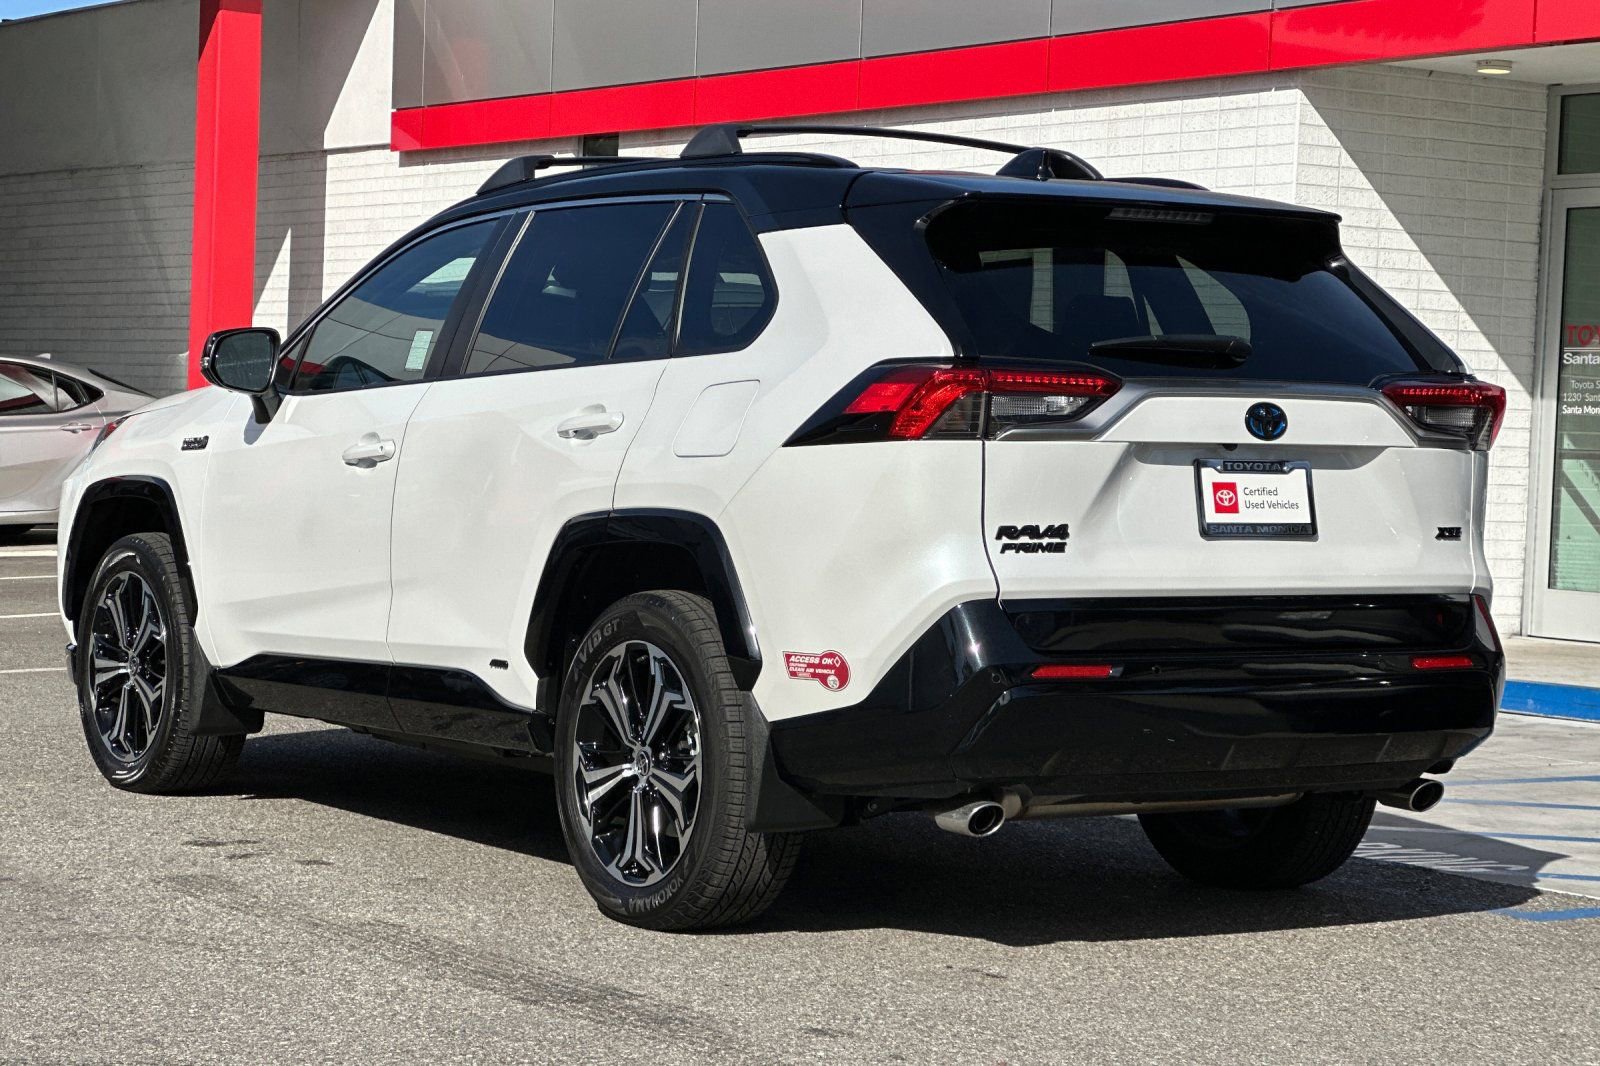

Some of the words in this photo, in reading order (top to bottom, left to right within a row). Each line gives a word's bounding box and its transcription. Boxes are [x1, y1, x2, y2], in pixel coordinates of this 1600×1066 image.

[1563, 352, 1600, 365] Santa
[1571, 380, 1595, 390] Toyota
[1563, 392, 1582, 402] 1230
[1562, 404, 1582, 414] Santa
[1225, 462, 1281, 471] TOYOTA
[1243, 487, 1278, 496] Certified
[1245, 500, 1265, 509] Used
[1267, 500, 1300, 510] Vehicles
[995, 524, 1070, 540] RAV4
[1210, 525, 1253, 534] SANTA
[1257, 525, 1310, 534] MONICA
[1000, 542, 1067, 554] PRIME
[603, 618, 620, 637] GT
[789, 655, 820, 664] ACCESS
[822, 657, 834, 665] OK
[628, 876, 684, 913] YOKOHAMA
